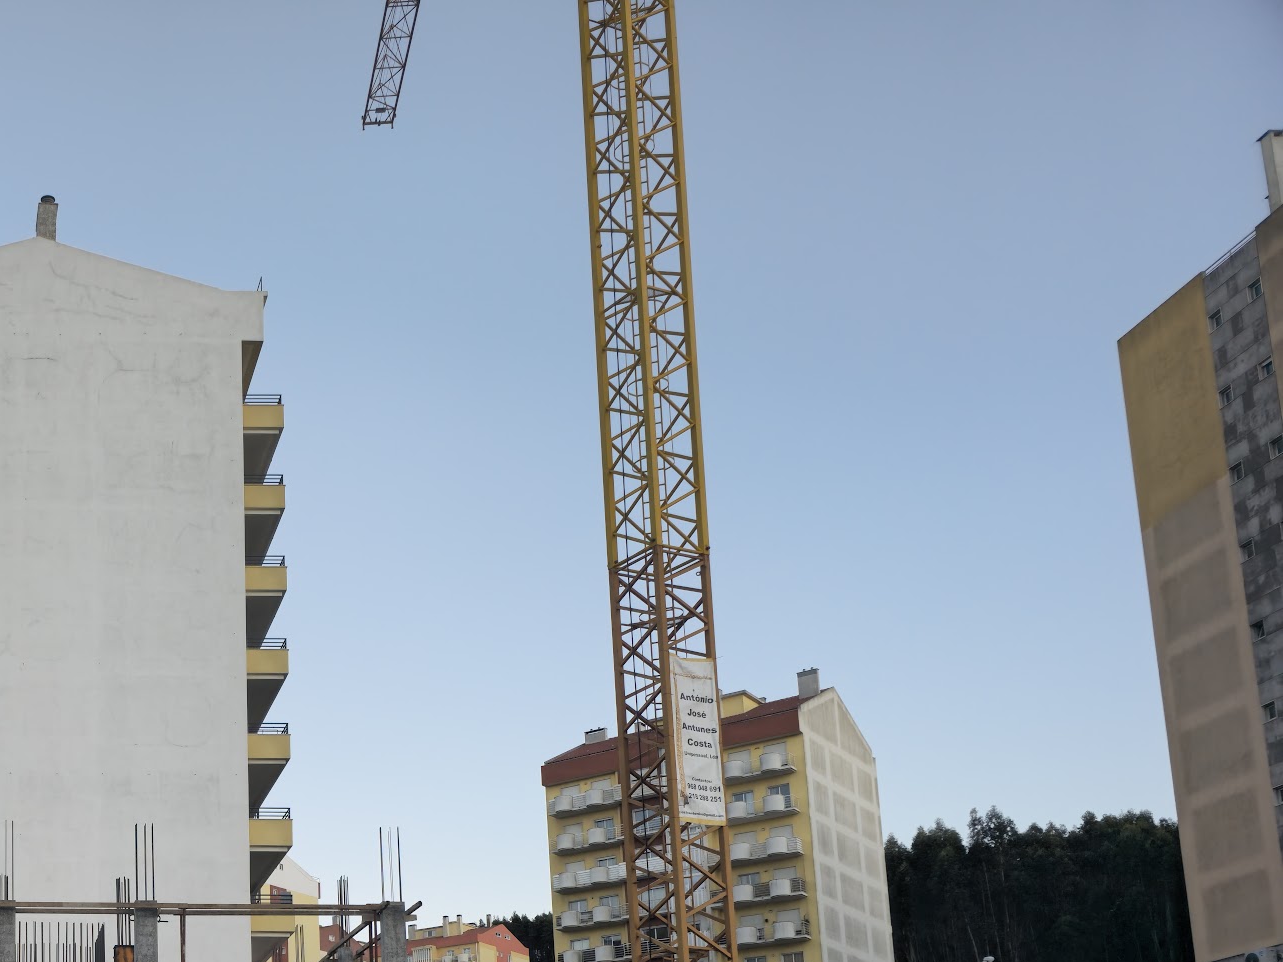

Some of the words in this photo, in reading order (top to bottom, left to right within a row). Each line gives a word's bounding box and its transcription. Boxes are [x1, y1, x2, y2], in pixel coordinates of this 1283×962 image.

[680, 693, 714, 704] António
[687, 709, 707, 719] José
[682, 722, 717, 734] Antunes
[687, 738, 713, 749] Costa
